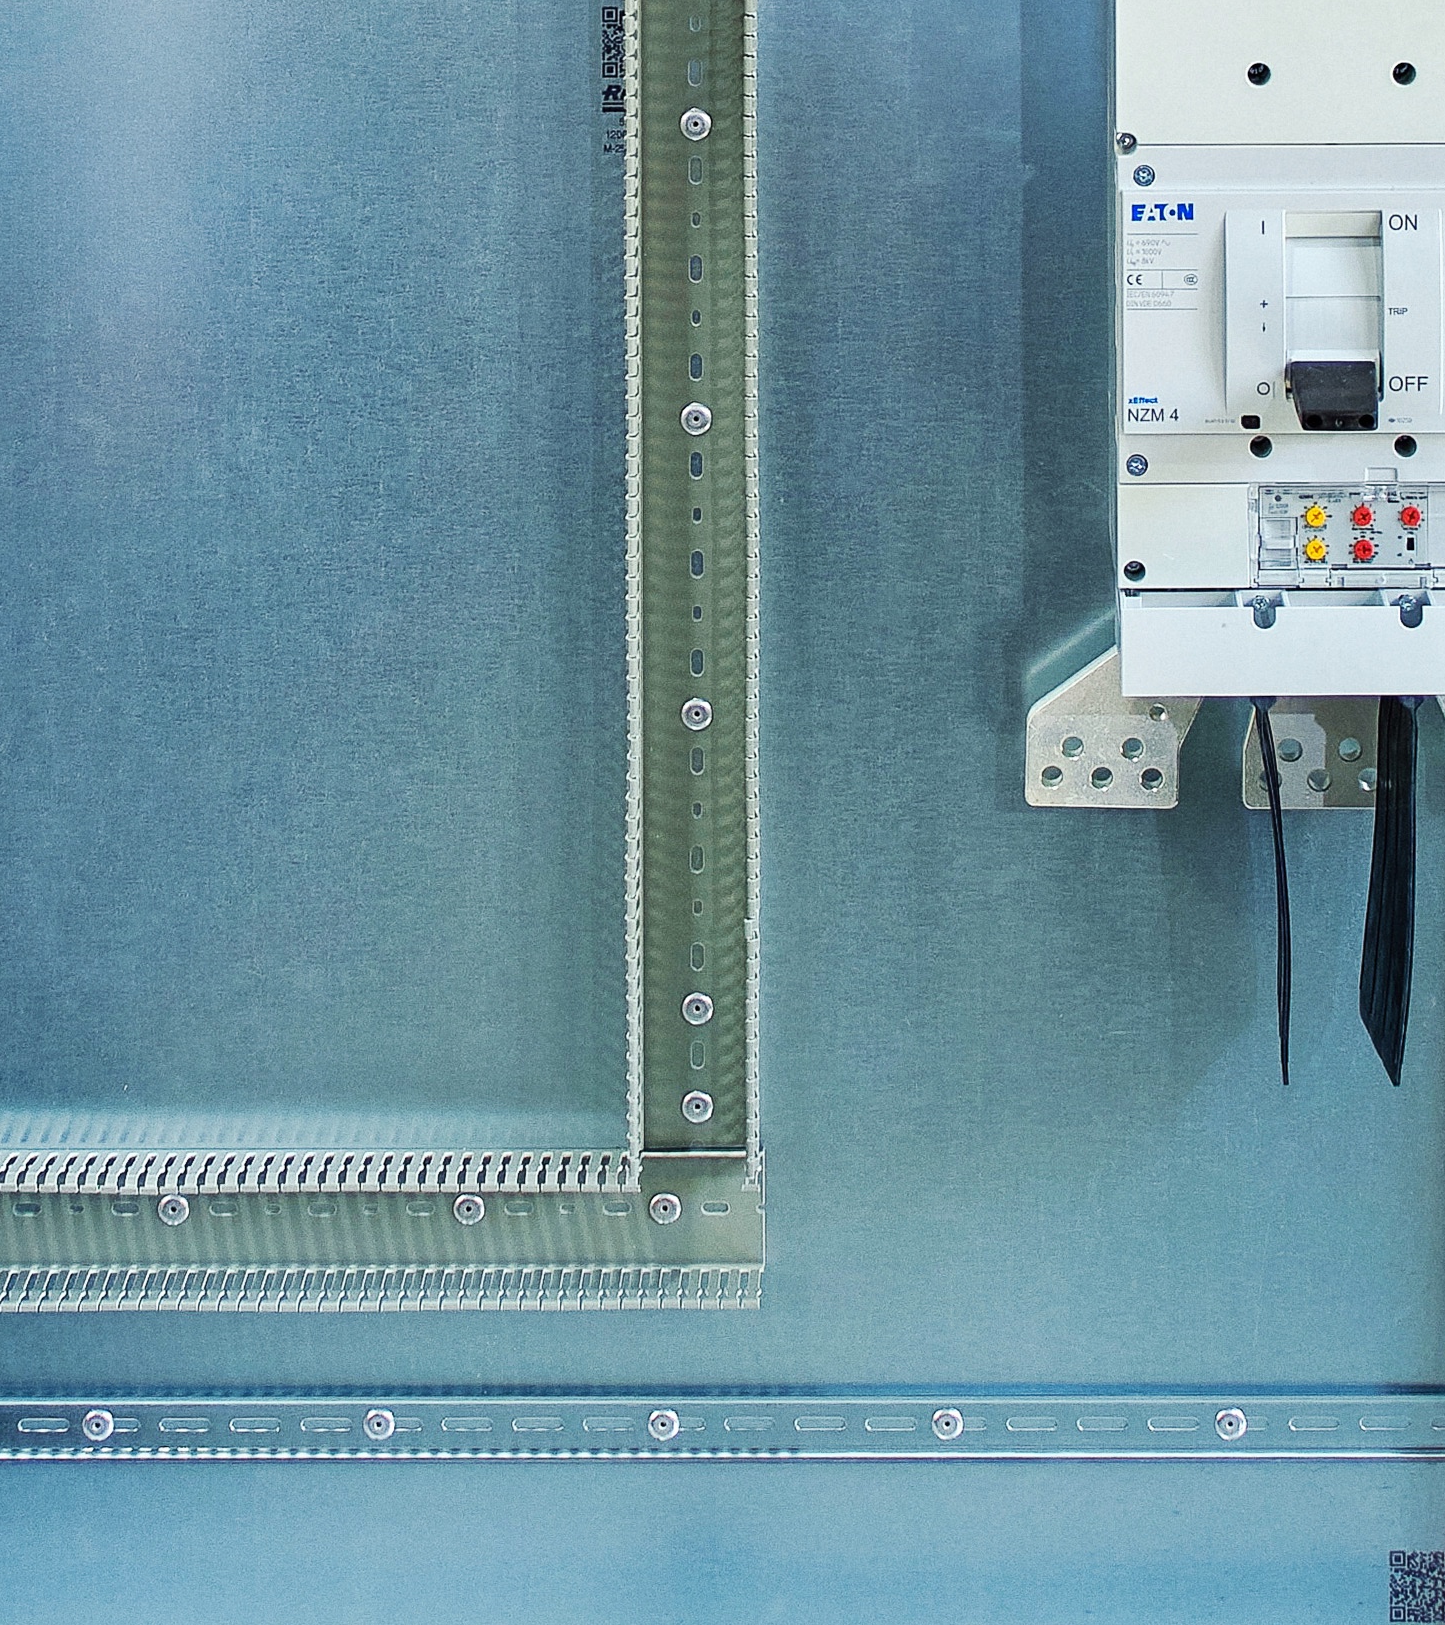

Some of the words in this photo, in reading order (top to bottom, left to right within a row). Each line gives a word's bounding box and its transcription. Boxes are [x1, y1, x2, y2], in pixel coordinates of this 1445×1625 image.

[1388, 214, 1418, 231] ON
[1388, 307, 1408, 315] TRIP
[1388, 376, 1429, 392] OFF
[1127, 408, 1165, 422] NZM
[1169, 408, 1179, 422] 4
